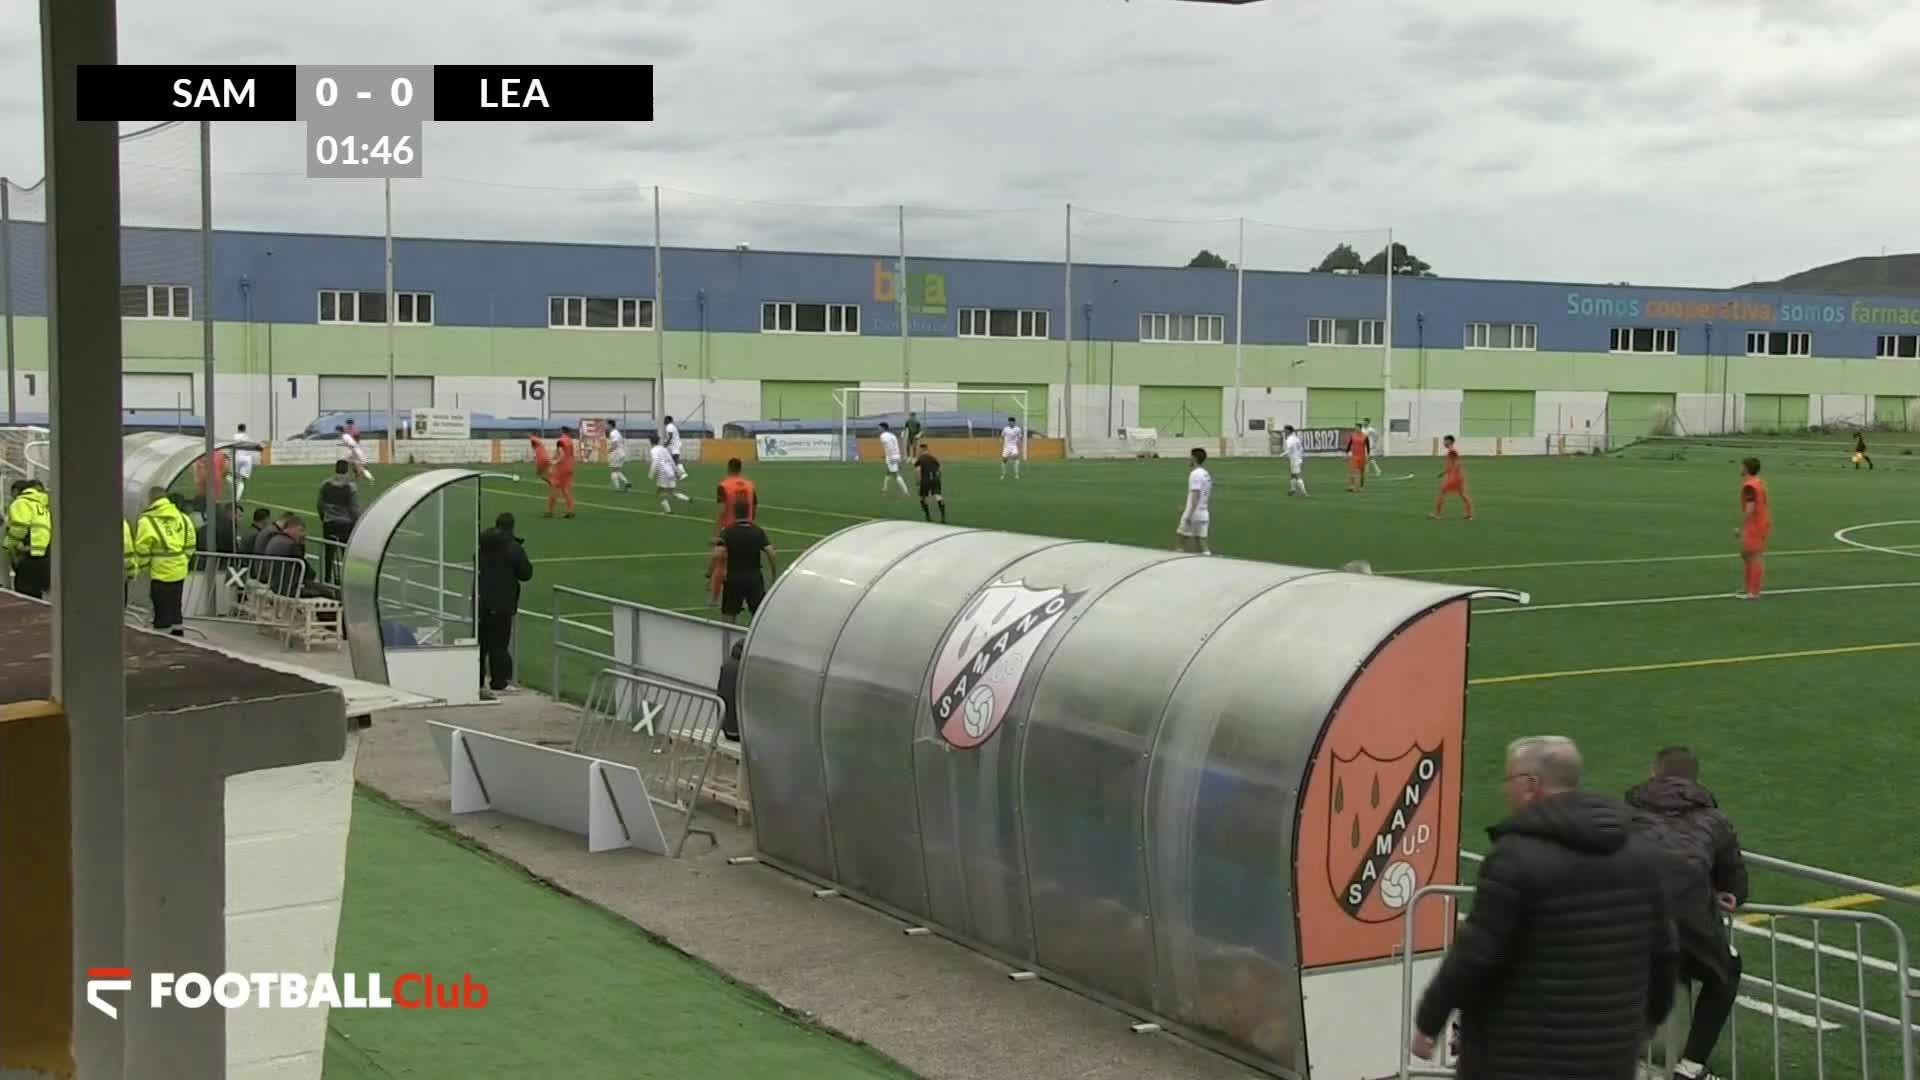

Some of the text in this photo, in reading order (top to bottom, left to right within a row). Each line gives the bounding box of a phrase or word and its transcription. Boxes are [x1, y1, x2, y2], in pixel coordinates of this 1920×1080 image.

[1567, 293, 1640, 318] Somos
[1780, 304, 1846, 323] somos
[517, 379, 545, 400] 16
[939, 597, 1065, 718] SAMANO
[1348, 758, 1434, 905] SAMANO
